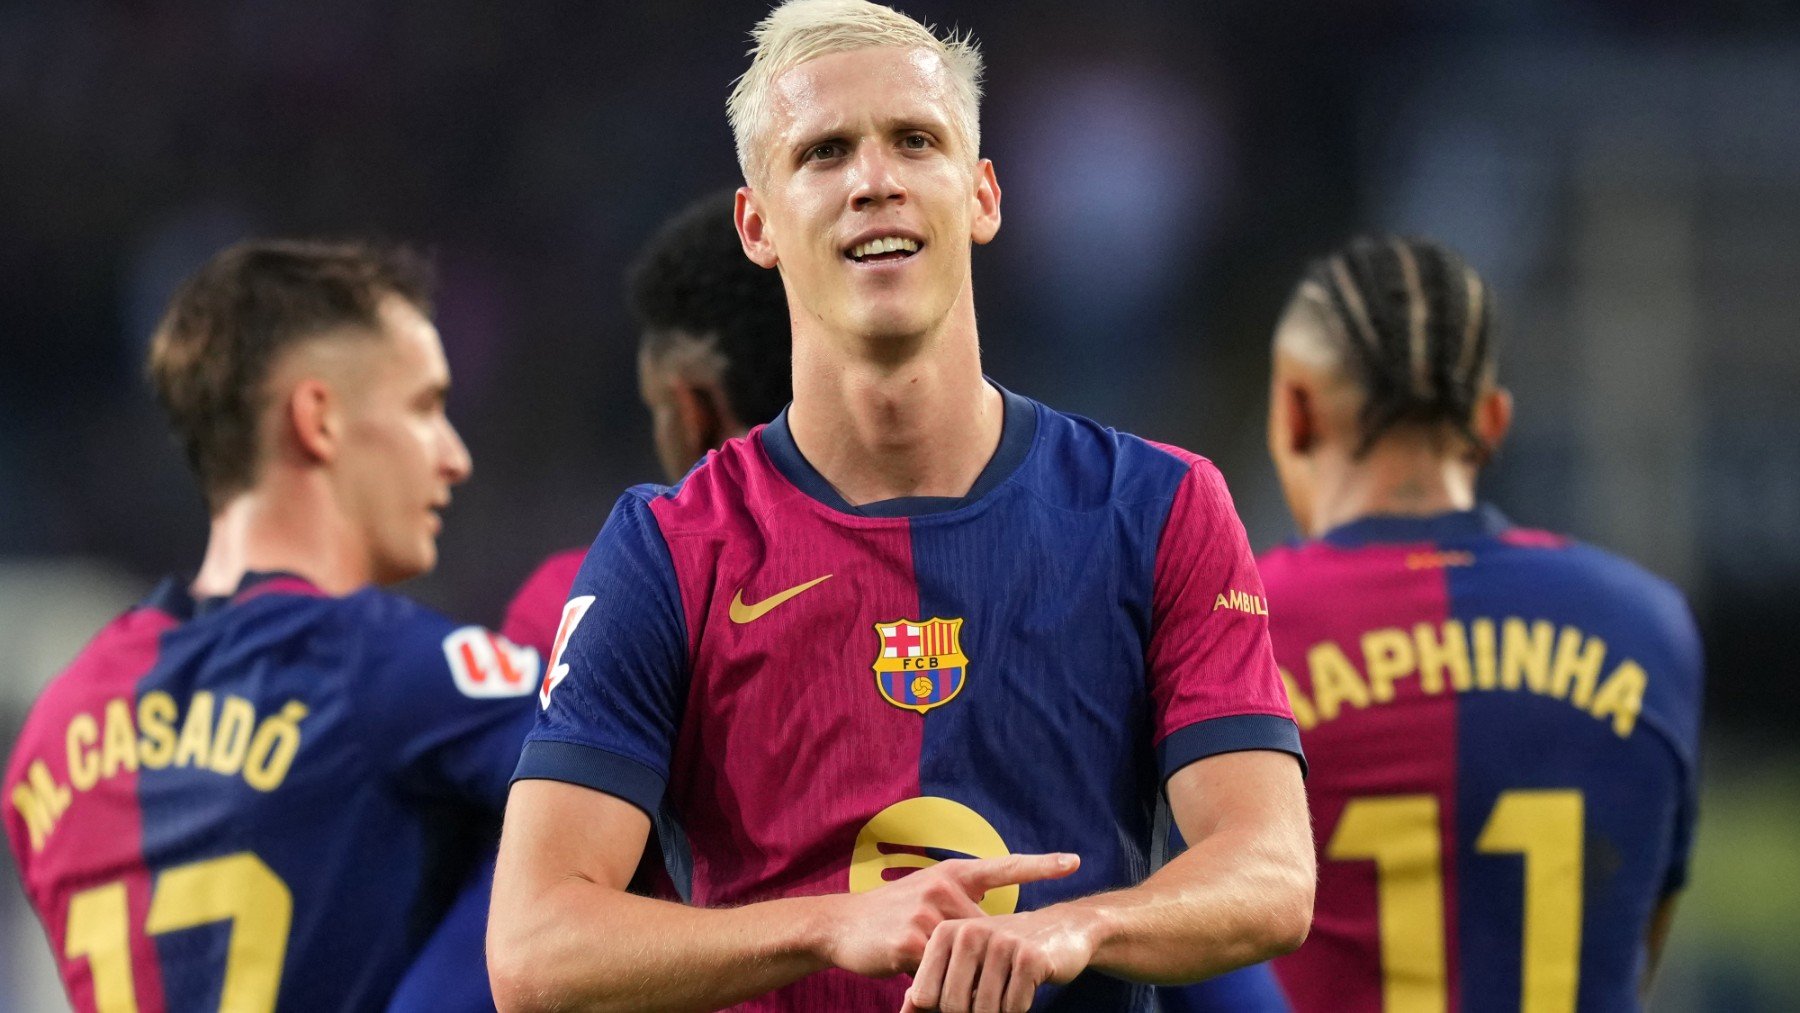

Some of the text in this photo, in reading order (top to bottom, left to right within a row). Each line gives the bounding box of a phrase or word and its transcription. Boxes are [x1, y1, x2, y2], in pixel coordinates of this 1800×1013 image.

[11, 690, 308, 853] M. CASADÓ
[66, 851, 294, 1013] 17
[1326, 789, 1585, 1013] 11
